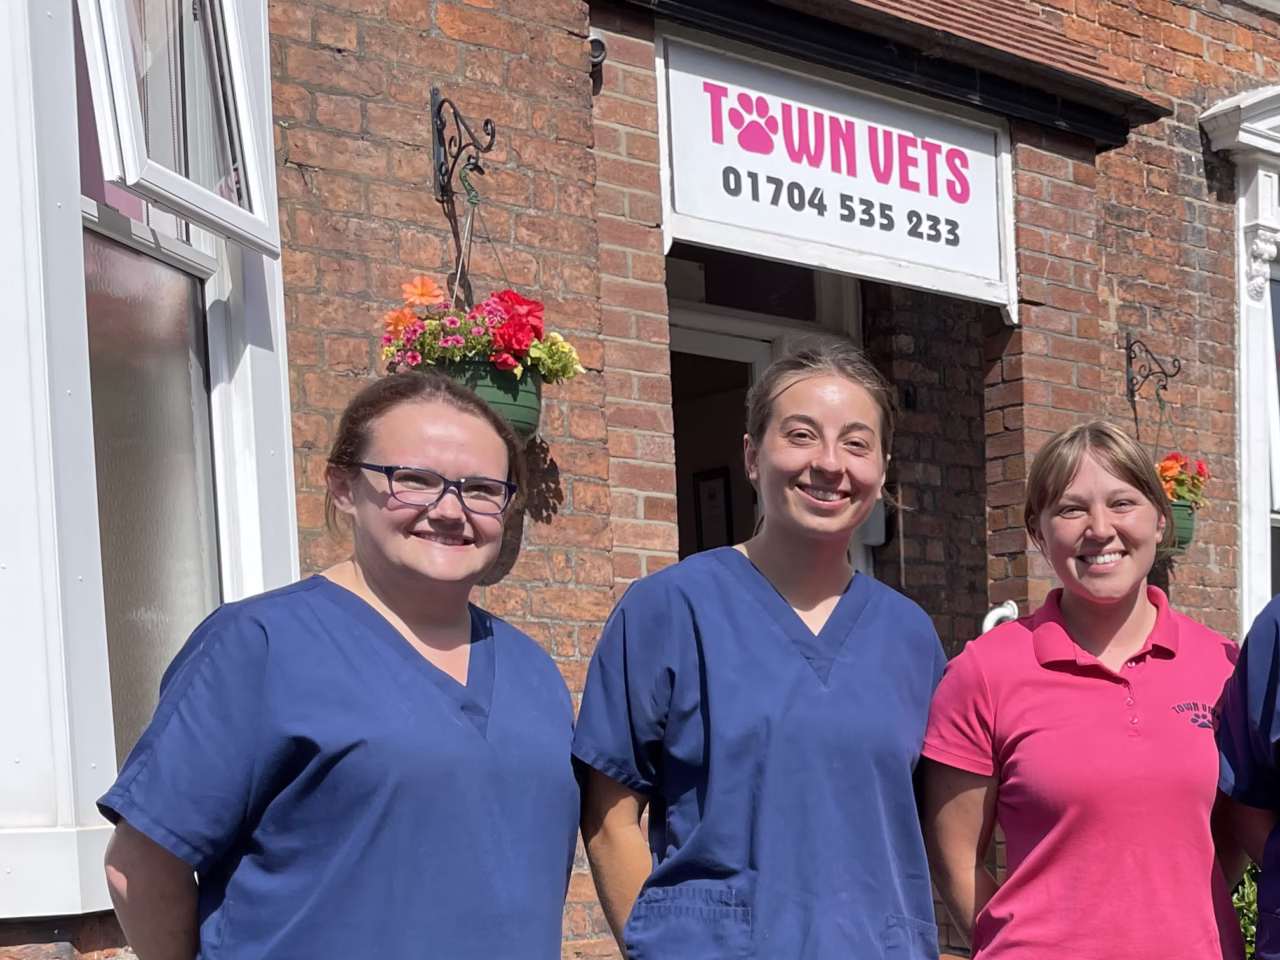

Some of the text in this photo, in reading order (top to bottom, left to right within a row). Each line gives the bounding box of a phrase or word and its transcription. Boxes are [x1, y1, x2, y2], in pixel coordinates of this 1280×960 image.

[867, 126, 970, 205] VETS
[722, 166, 960, 247] 01704 535 233
[1171, 701, 1200, 714] TOWN
